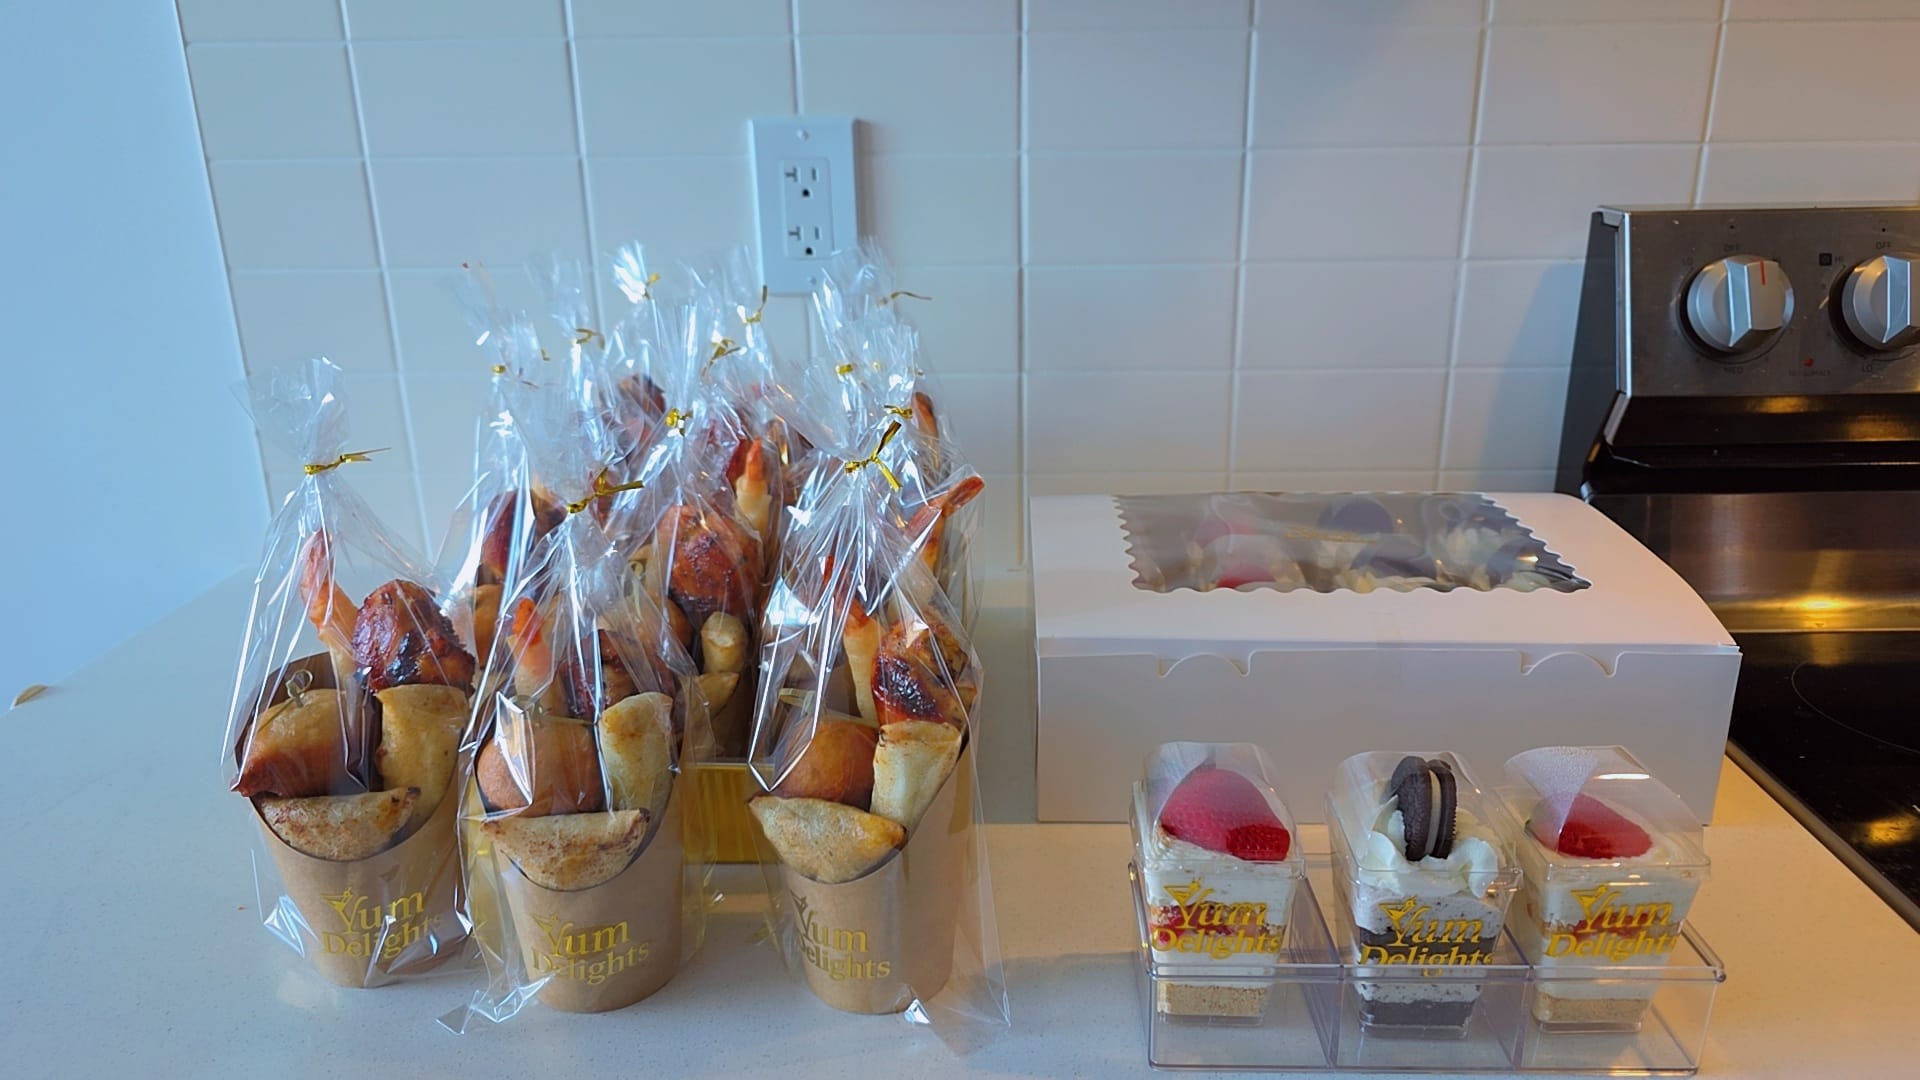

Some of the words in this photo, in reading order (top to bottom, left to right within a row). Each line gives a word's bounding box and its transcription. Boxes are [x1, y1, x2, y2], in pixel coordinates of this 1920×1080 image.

[321, 887, 425, 935] Yum
[790, 889, 869, 953] Yum
[1164, 880, 1268, 930] Yum
[1378, 895, 1484, 947] Yum
[1571, 884, 1674, 933] Yum
[322, 914, 441, 959] Delghts
[531, 912, 631, 958] Yum
